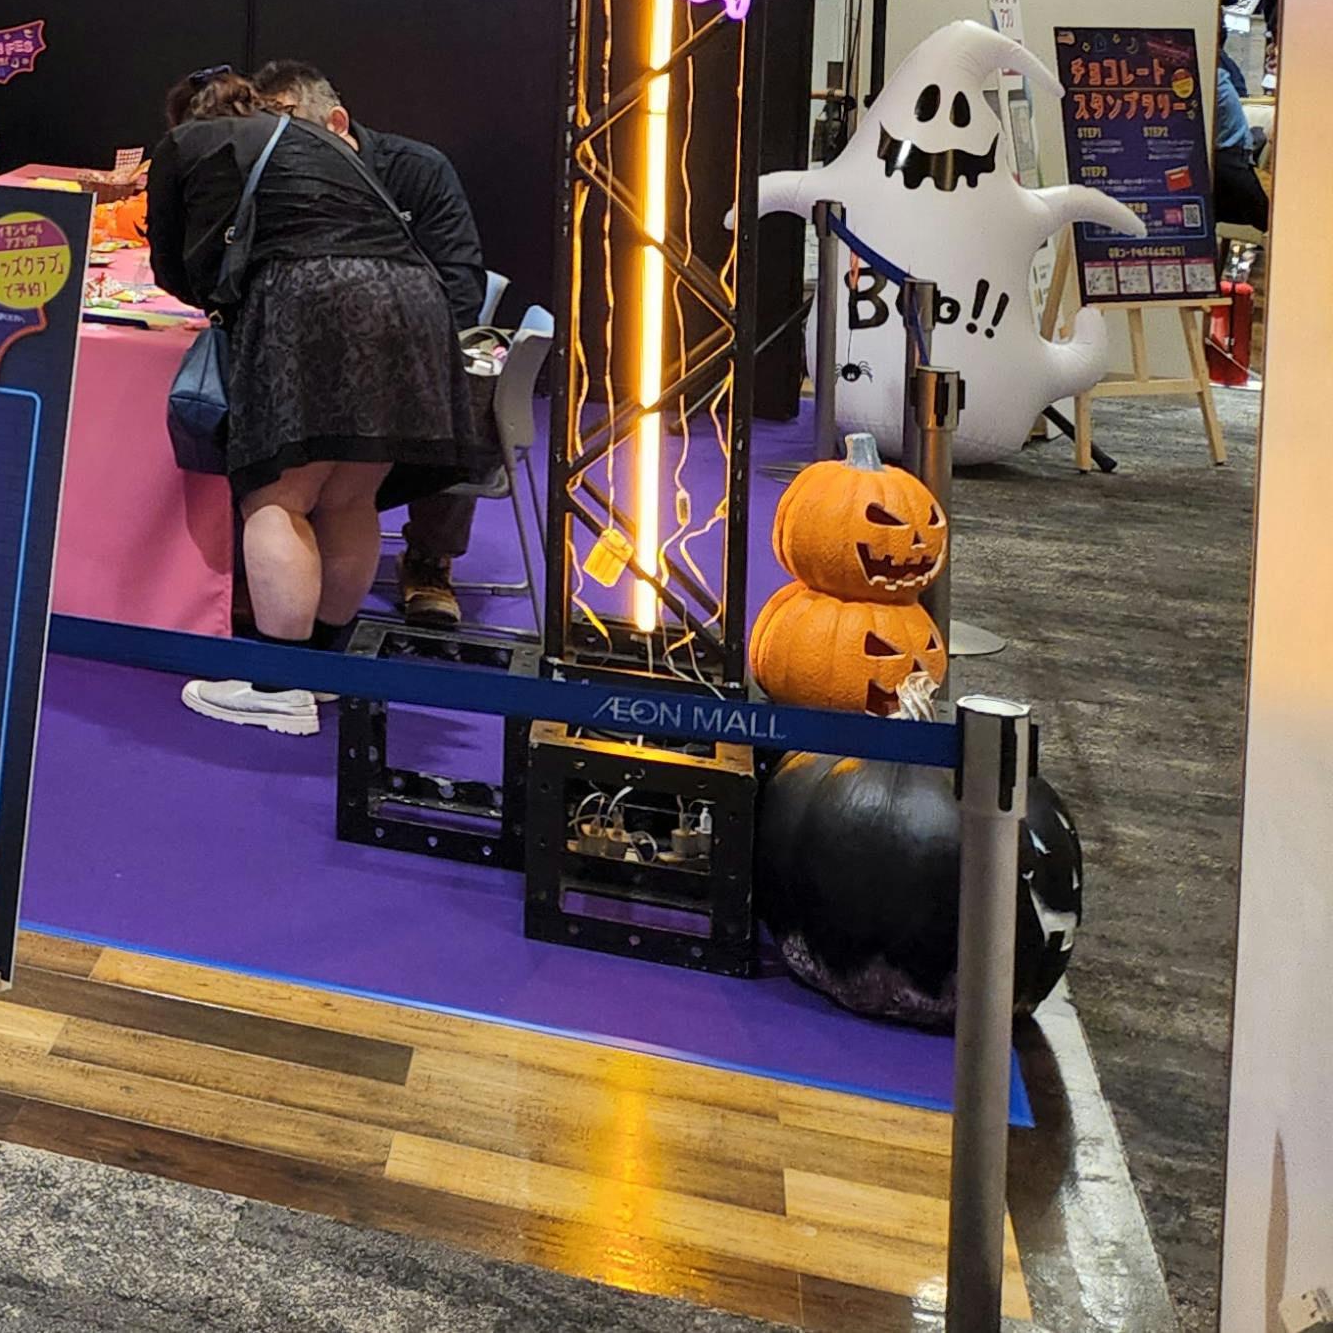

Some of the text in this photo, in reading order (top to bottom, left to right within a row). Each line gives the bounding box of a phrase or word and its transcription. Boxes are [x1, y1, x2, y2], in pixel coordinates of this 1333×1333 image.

[1070, 58, 1166, 86] チョコレート
[1073, 92, 1186, 120] スタンプラリー
[693, 706, 786, 739] MALL
